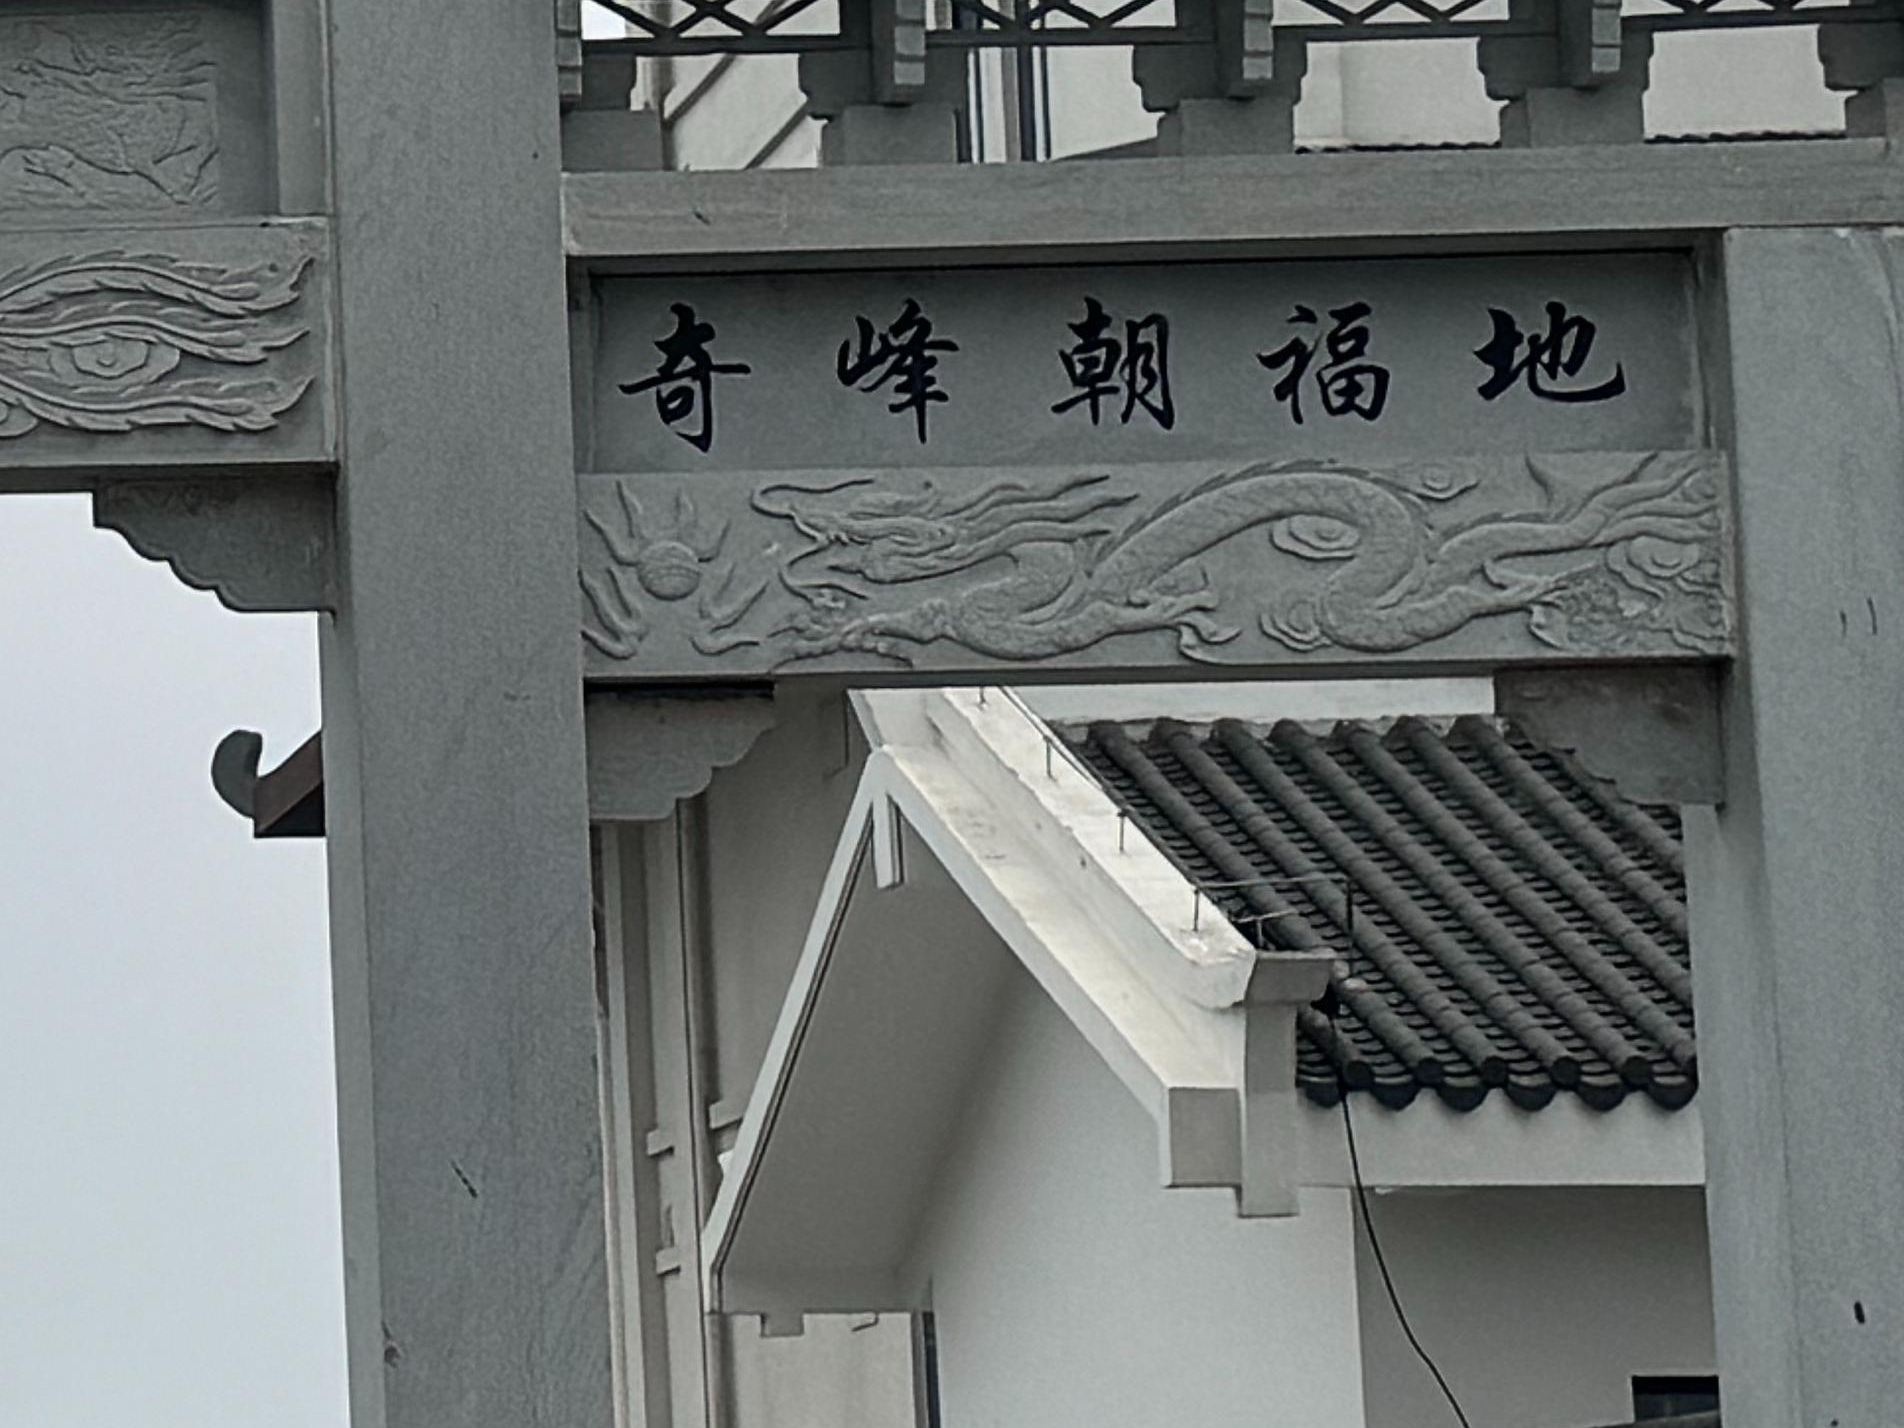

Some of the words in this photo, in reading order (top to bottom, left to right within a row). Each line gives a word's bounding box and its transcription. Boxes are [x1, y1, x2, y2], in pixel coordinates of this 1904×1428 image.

[617, 296, 1626, 452] 奇峰朝福地
